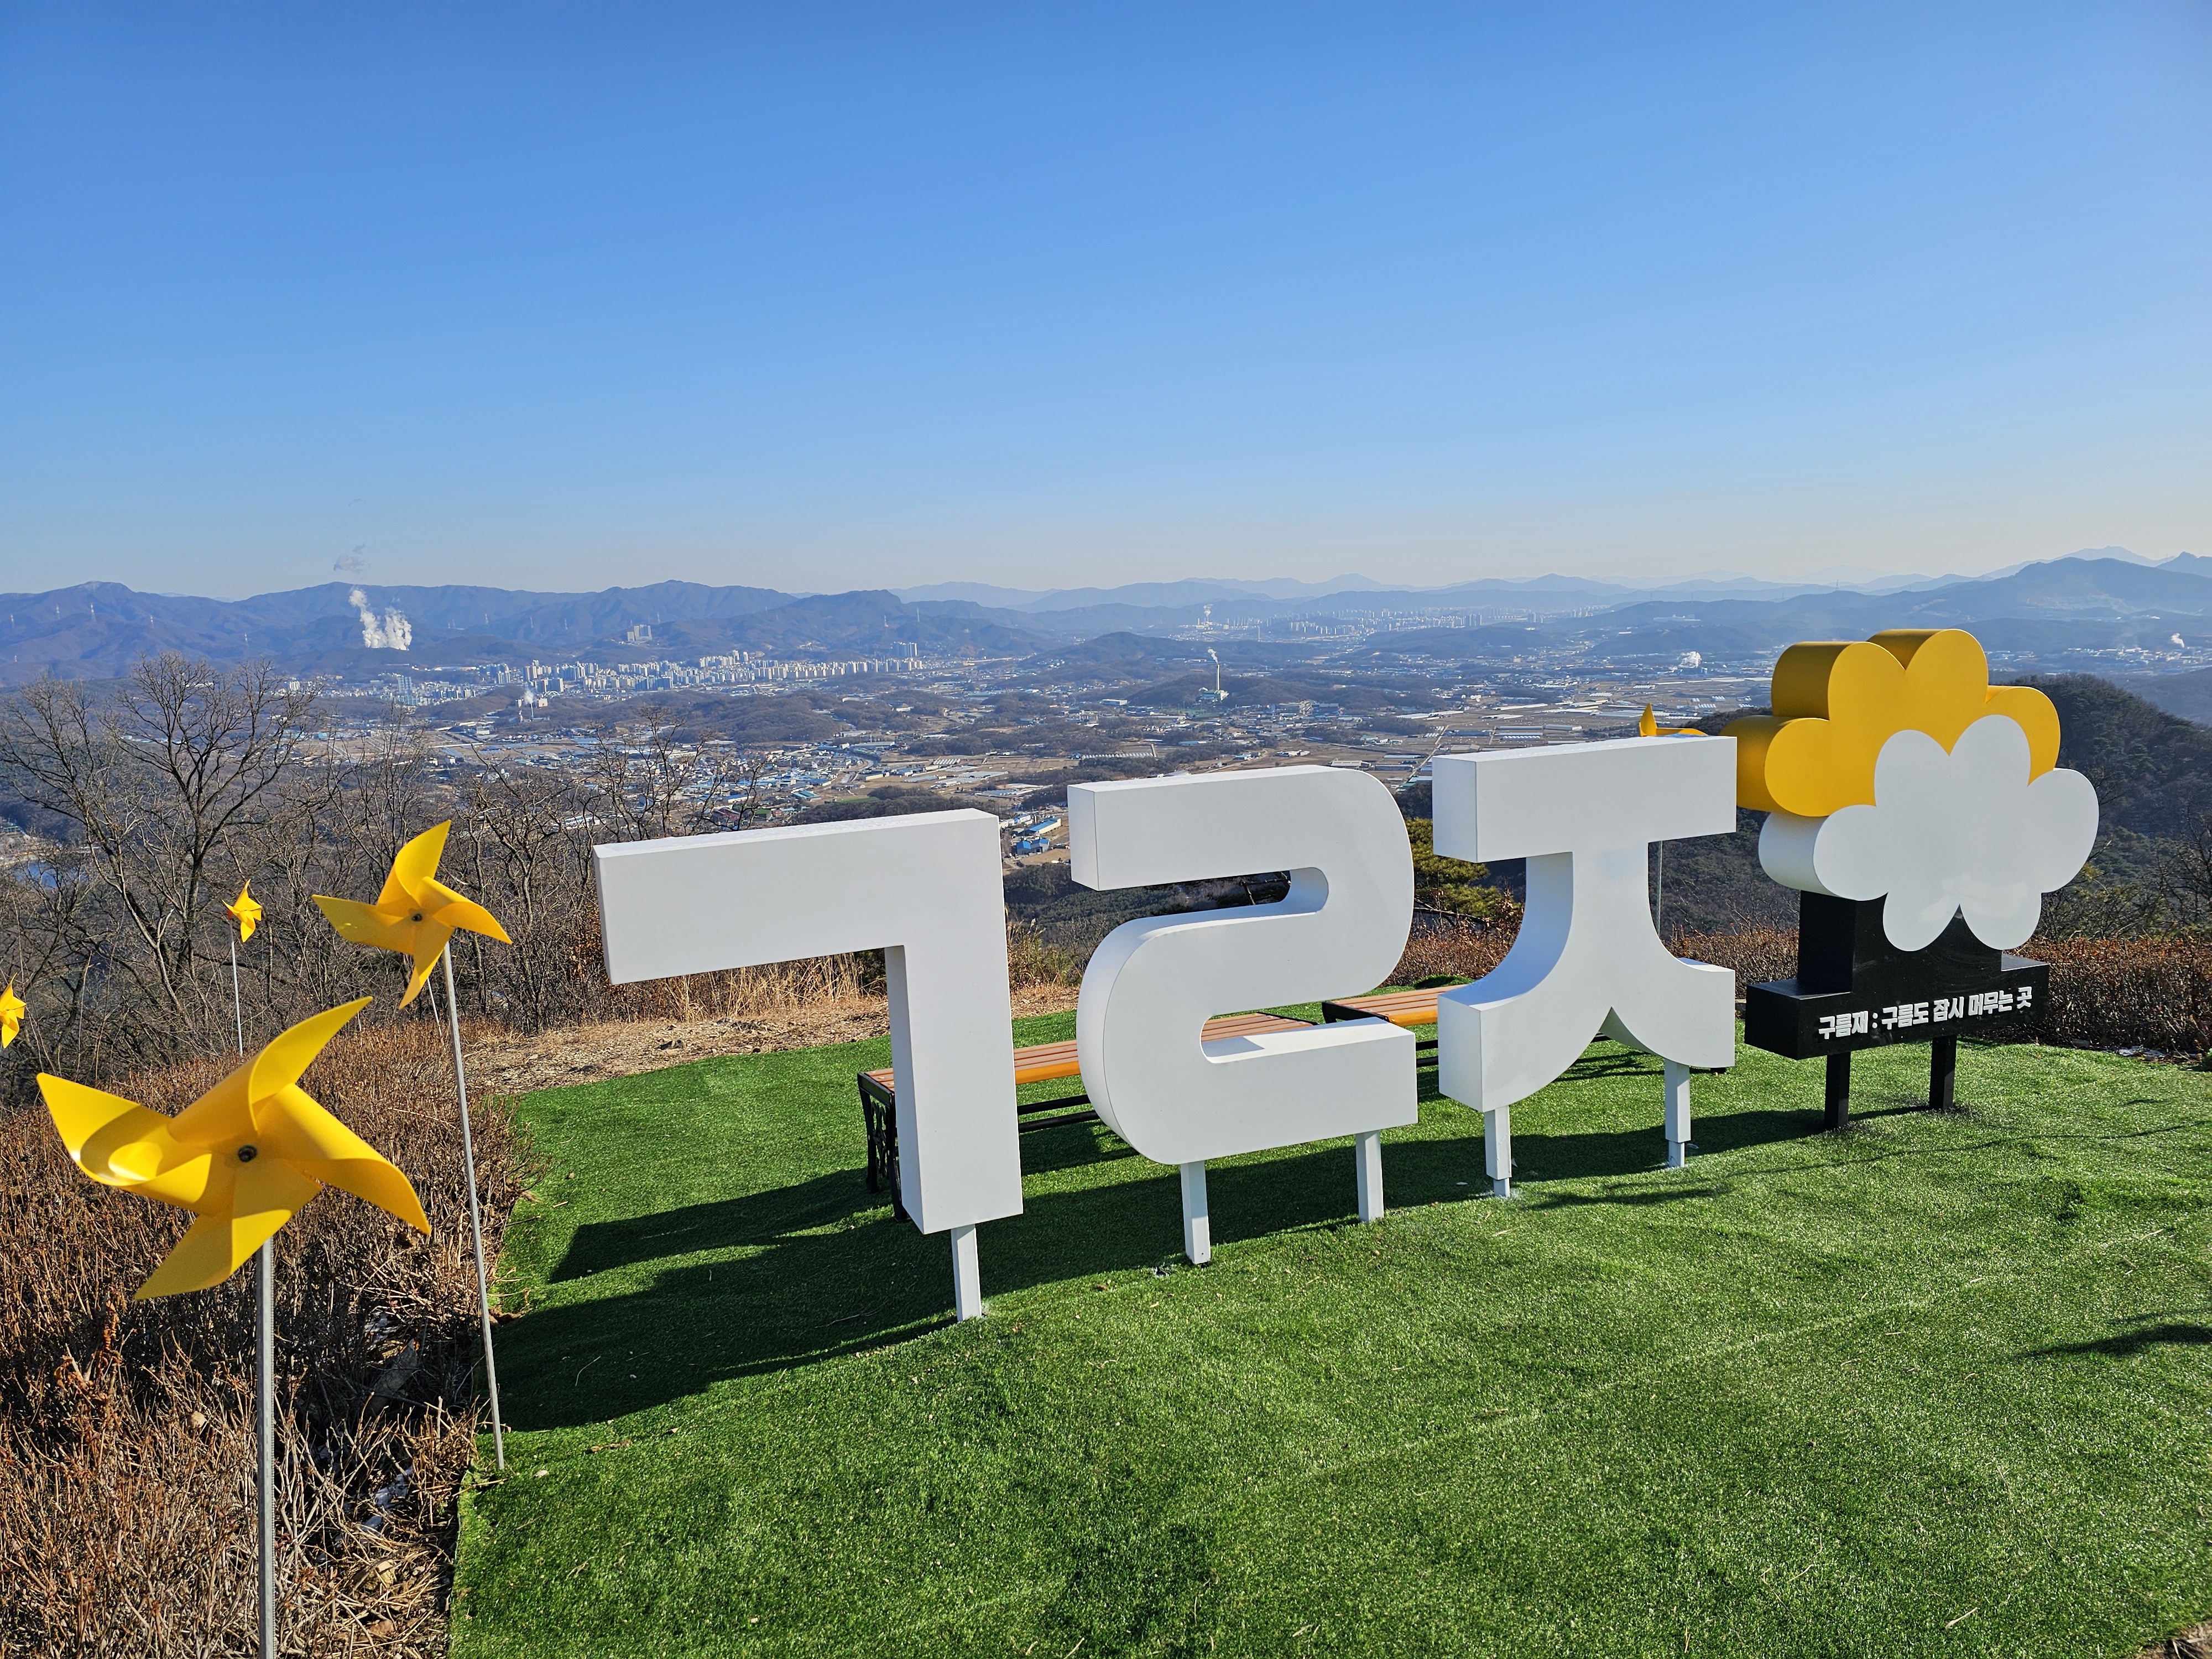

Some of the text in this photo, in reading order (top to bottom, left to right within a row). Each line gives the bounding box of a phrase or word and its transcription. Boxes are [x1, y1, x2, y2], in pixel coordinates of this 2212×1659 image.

[1818, 1010, 1869, 1040] 구름재
[1881, 1001, 1929, 1030] 구름도
[1933, 996, 1965, 1022] 잠시
[1968, 990, 2013, 1016] 머무는
[2016, 986, 2032, 1009] 곳
